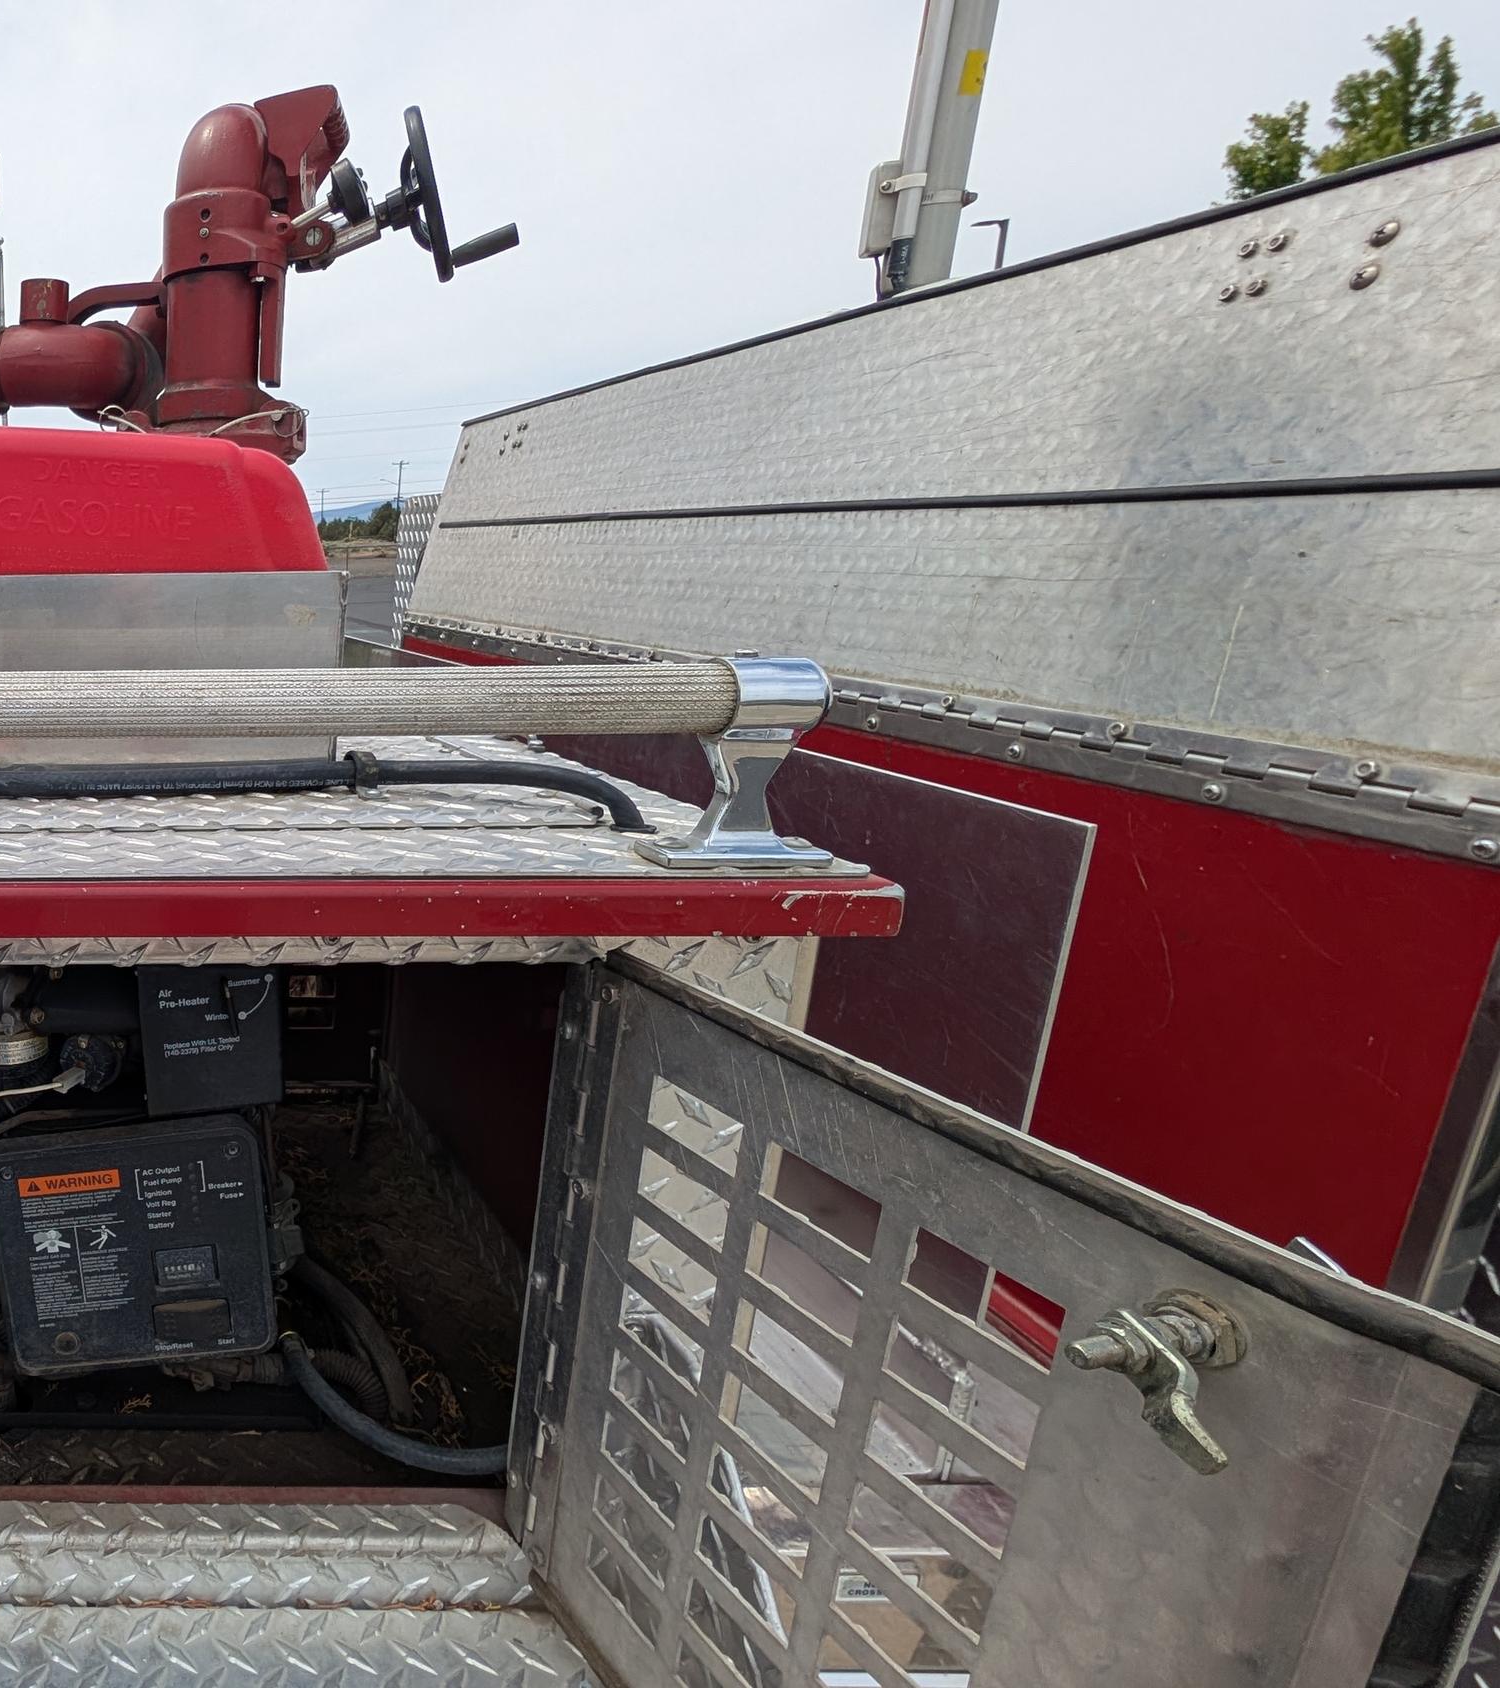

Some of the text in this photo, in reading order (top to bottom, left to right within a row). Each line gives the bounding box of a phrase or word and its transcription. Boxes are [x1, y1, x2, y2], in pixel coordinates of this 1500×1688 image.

[32, 457, 164, 488] DANGER
[227, 977, 261, 988] Summer
[157, 989, 172, 998] Air
[158, 997, 211, 1009] Pre-Heater
[204, 1013, 229, 1022] Winte
[163, 1041, 190, 1051] Replace
[191, 1039, 207, 1047] With
[218, 1035, 241, 1045] Tested
[217, 1043, 235, 1052] Only
[155, 1166, 180, 1175] Output
[45, 1173, 113, 1190] WARNING
[143, 1177, 182, 1187] Fuel Pump
[207, 1181, 238, 1190] Breaker
[144, 1189, 172, 1199] Ignition
[219, 1192, 238, 1200] Fuse
[161, 1199, 177, 1207] Reg
[147, 1211, 172, 1219] Starter
[148, 1221, 175, 1230] Battery
[217, 1337, 236, 1346] Start
[154, 1341, 194, 1352] Stop/Reset
